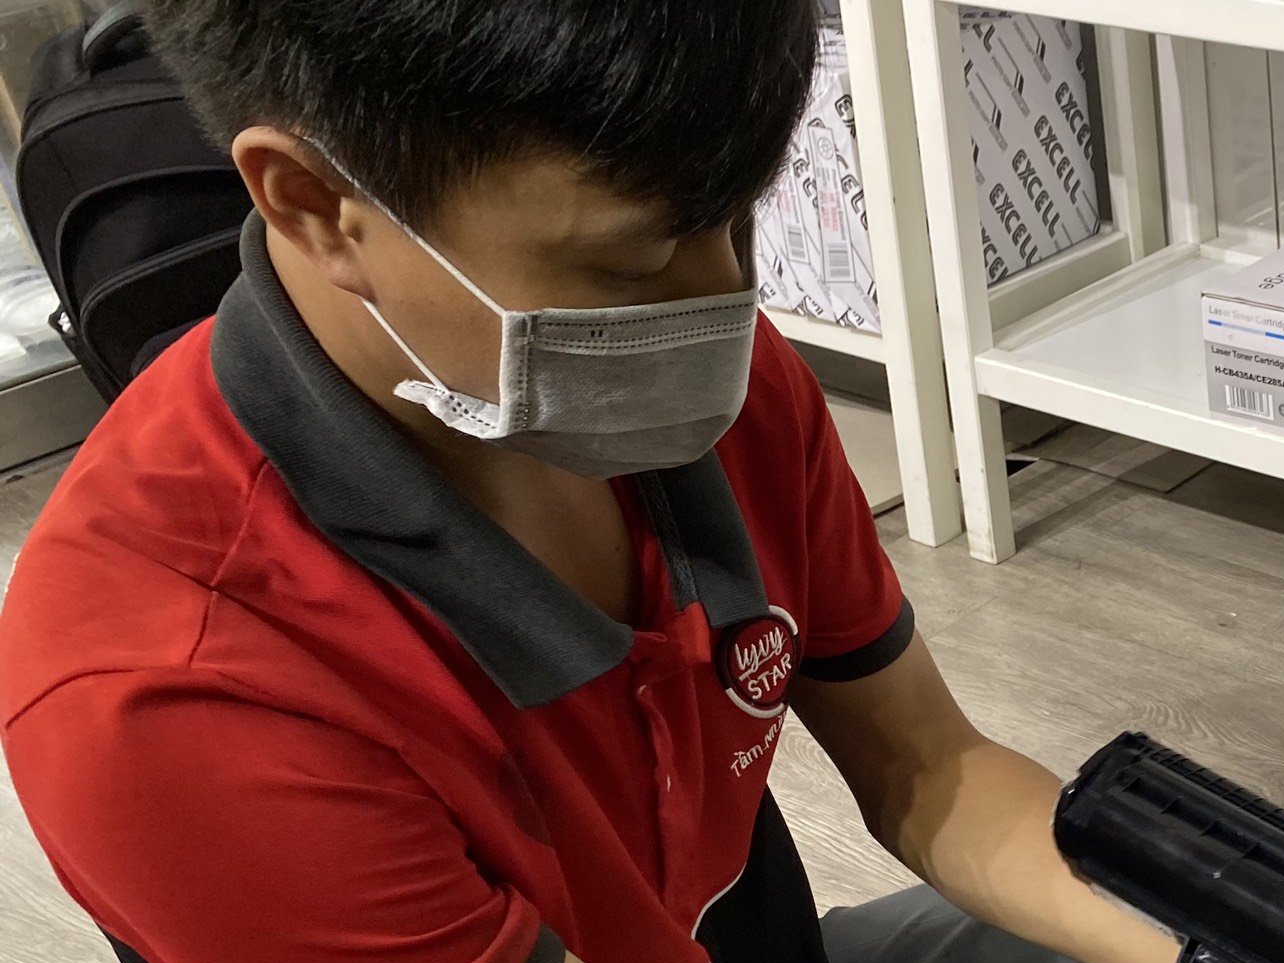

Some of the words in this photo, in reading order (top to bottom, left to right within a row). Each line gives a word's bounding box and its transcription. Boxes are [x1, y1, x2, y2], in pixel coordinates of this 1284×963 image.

[1012, 149, 1061, 239] EXCELL
[1034, 115, 1081, 205] EXCELL
[1211, 345, 1231, 357] Laser
[1232, 350, 1253, 361] Toner
[747, 652, 792, 701] STAR
